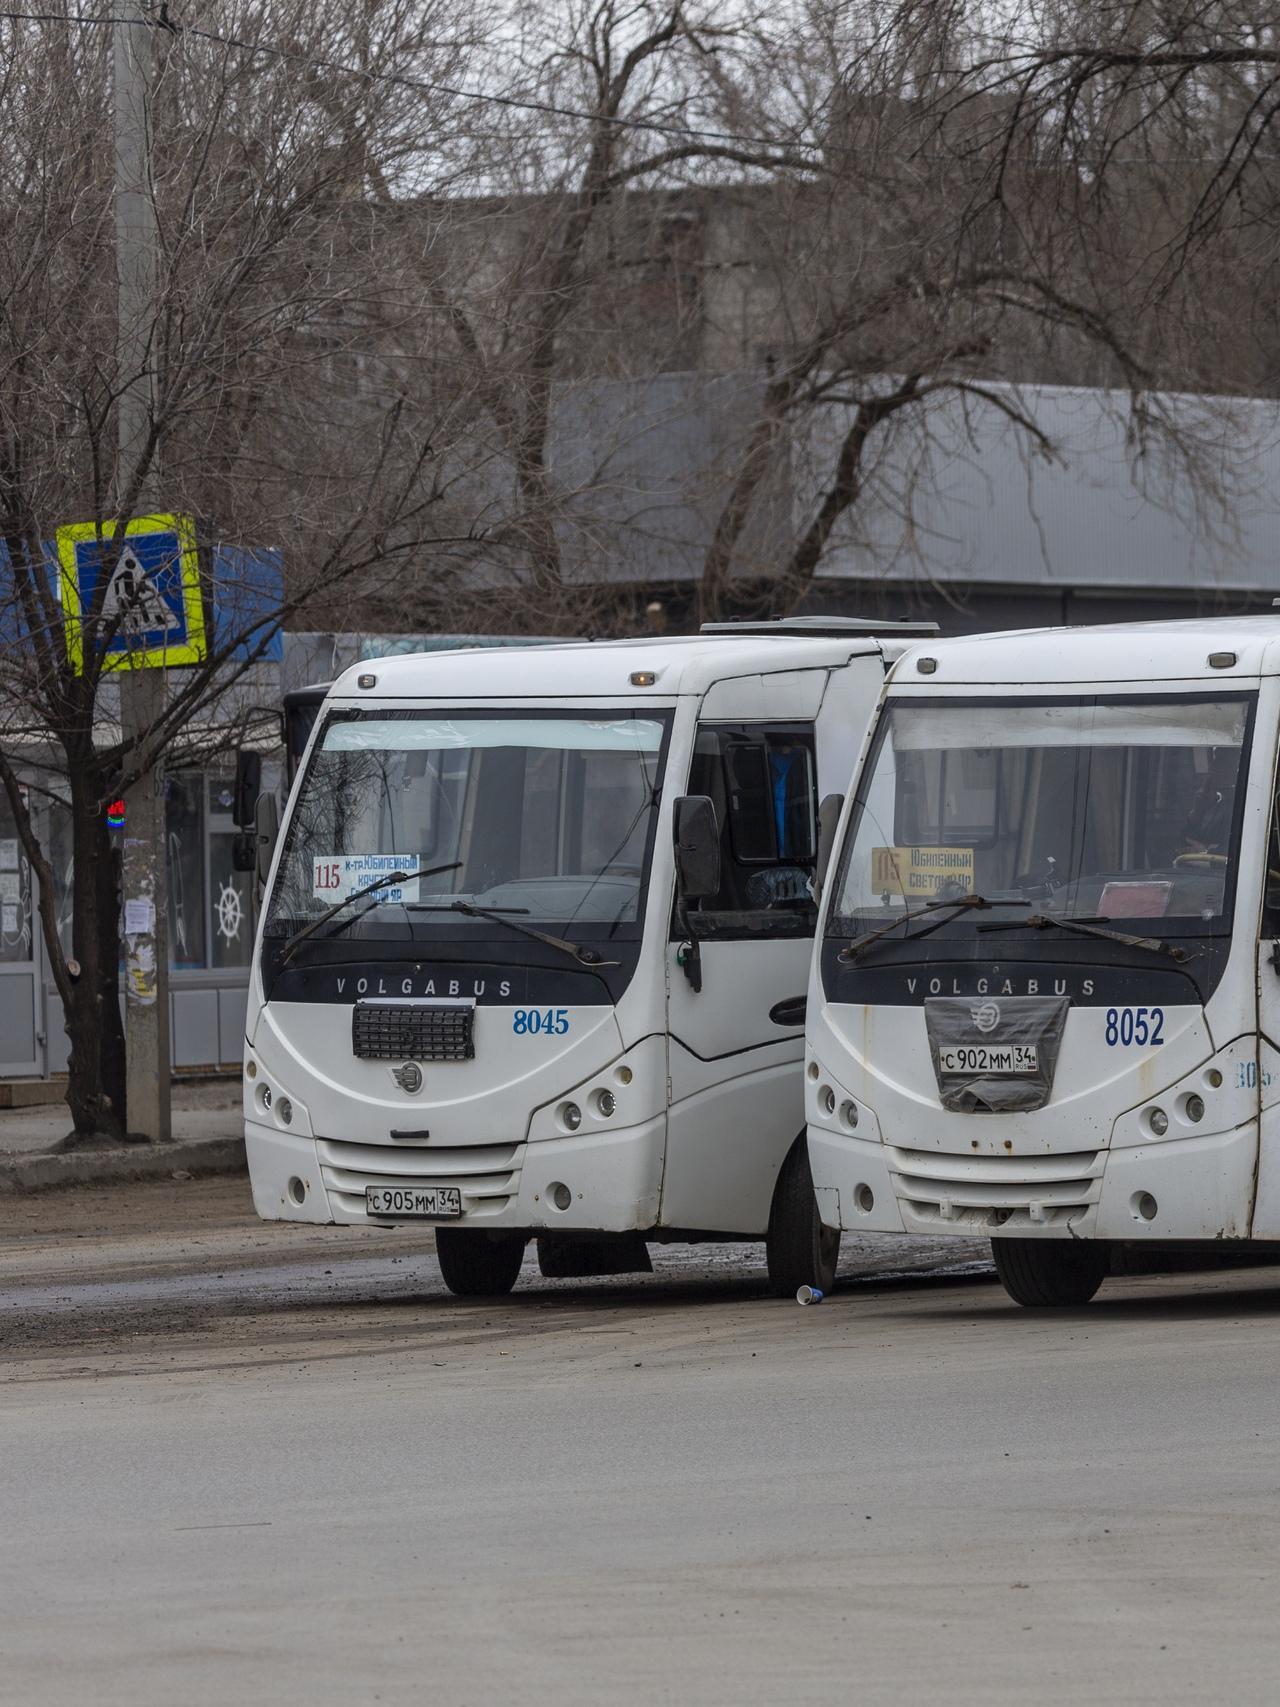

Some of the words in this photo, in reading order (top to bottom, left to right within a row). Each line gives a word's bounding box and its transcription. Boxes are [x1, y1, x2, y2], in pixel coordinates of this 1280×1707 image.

[315, 864, 340, 889] 115
[337, 978, 511, 996] VOLGABUS
[907, 978, 1095, 996] VOLGABUS
[512, 1009, 570, 1035] 8045
[1105, 1008, 1164, 1046] 8052
[1014, 1047, 1032, 1063] 34
[439, 1190, 455, 1206] 34
